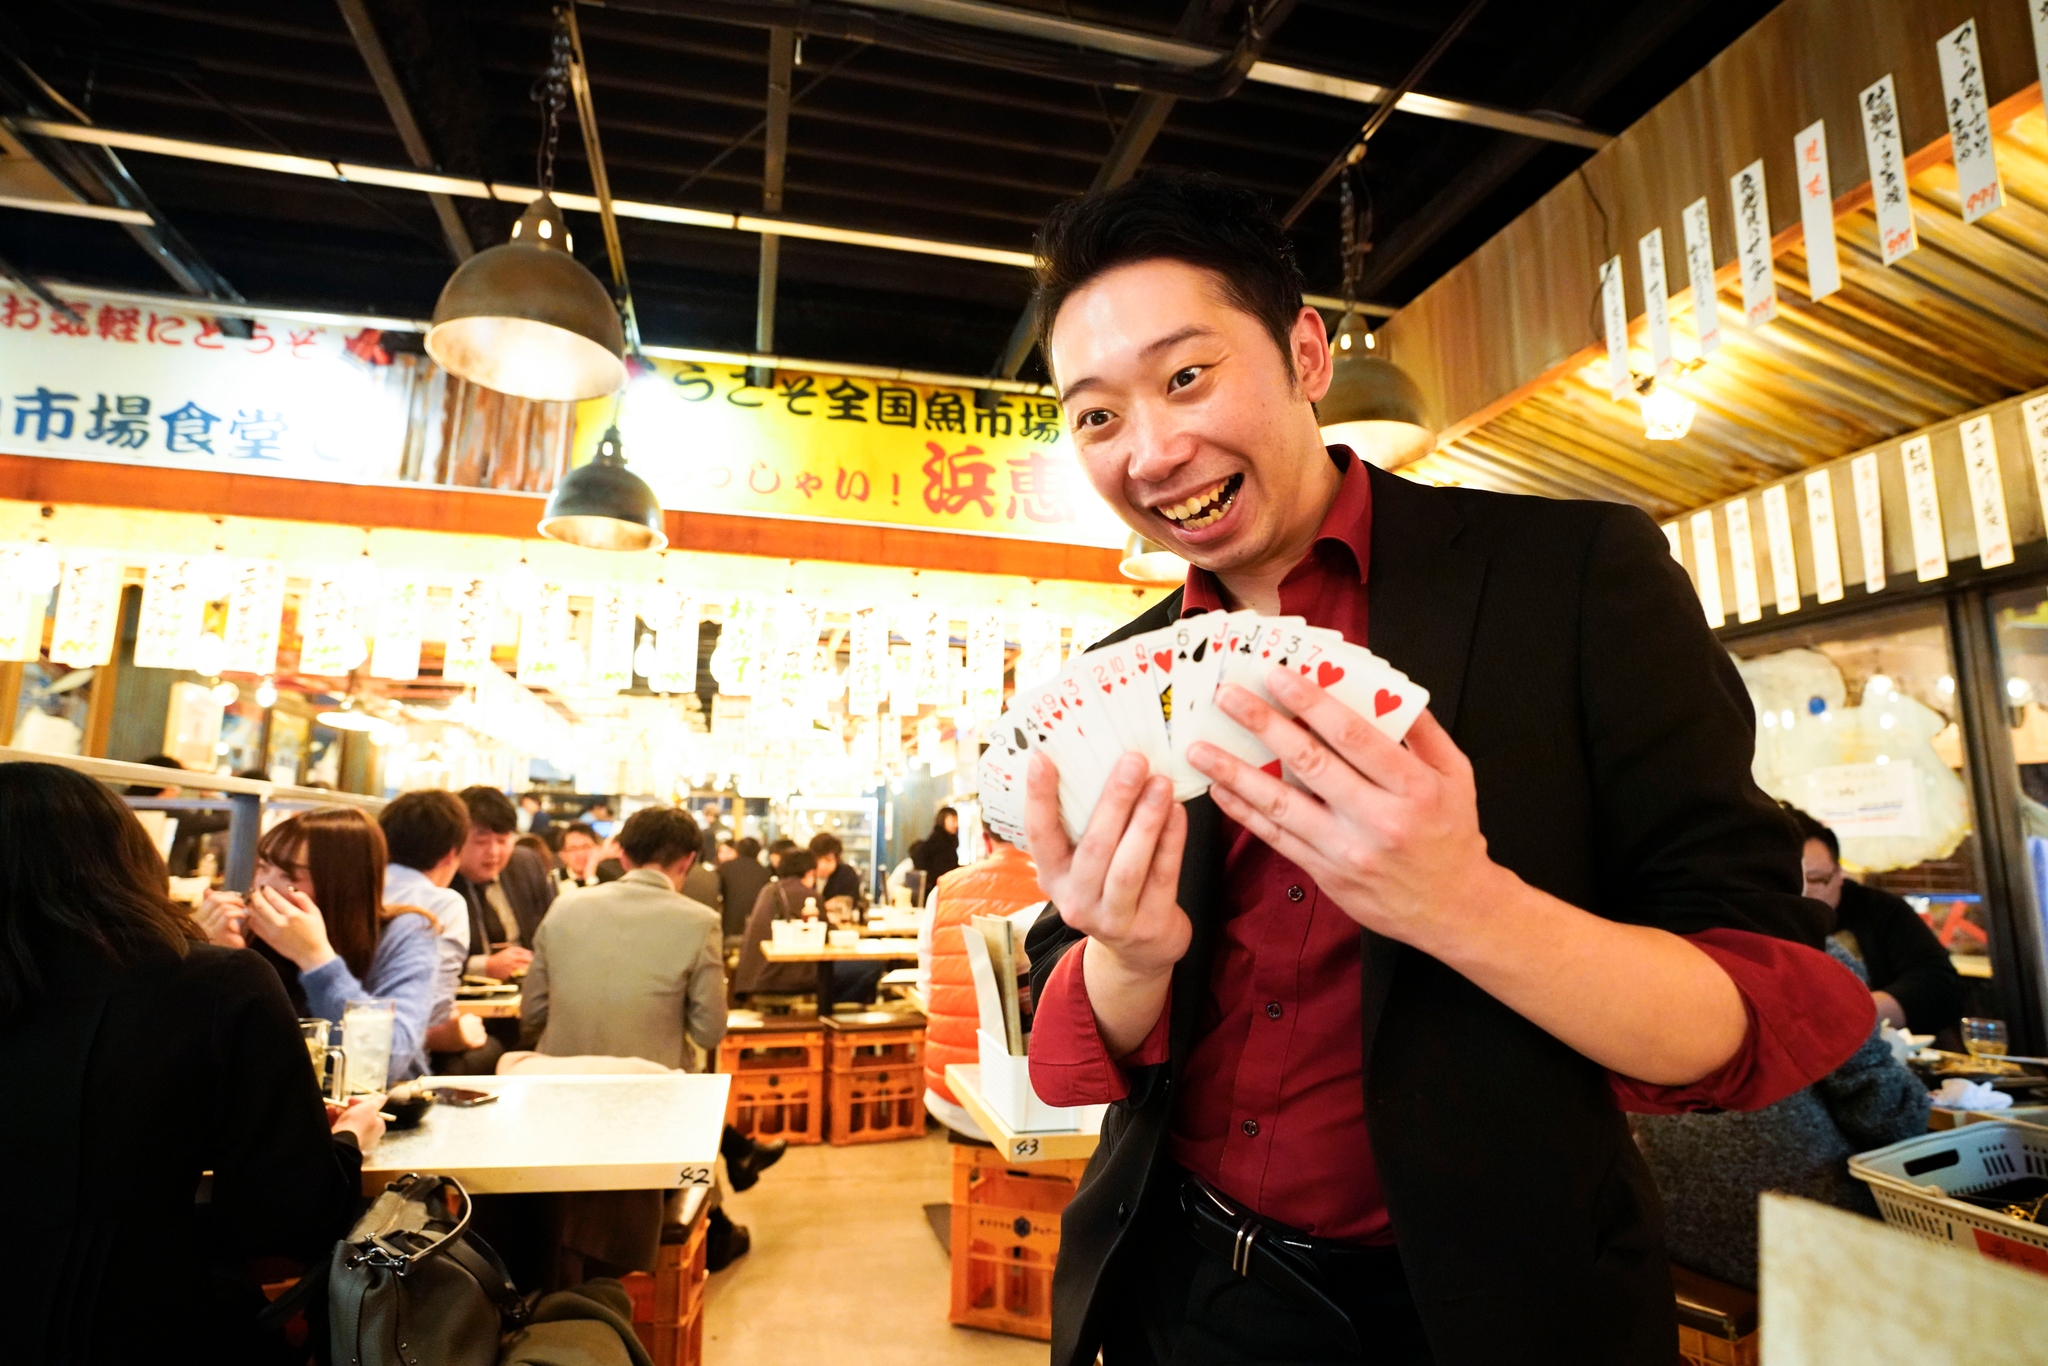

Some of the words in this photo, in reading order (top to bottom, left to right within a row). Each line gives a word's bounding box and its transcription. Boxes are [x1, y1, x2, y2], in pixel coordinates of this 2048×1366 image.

[666, 364, 1060, 443] うこそ全国魚市場
[1177, 628, 1190, 646] 6
[1214, 622, 1229, 640] J
[1245, 625, 1261, 641] J
[1266, 628, 1281, 647] 5
[1135, 643, 1148, 661] Q
[1285, 635, 1301, 654] 3
[1307, 645, 1323, 662] 7
[1093, 665, 1109, 683] 2
[1109, 656, 1125, 674] 10
[1063, 678, 1080, 696] 3
[1042, 693, 1057, 710] 9
[1026, 717, 1040, 731] 4
[990, 731, 1007, 747] 5
[1016, 1139, 1039, 1156] 43
[679, 1167, 711, 1186] 42
